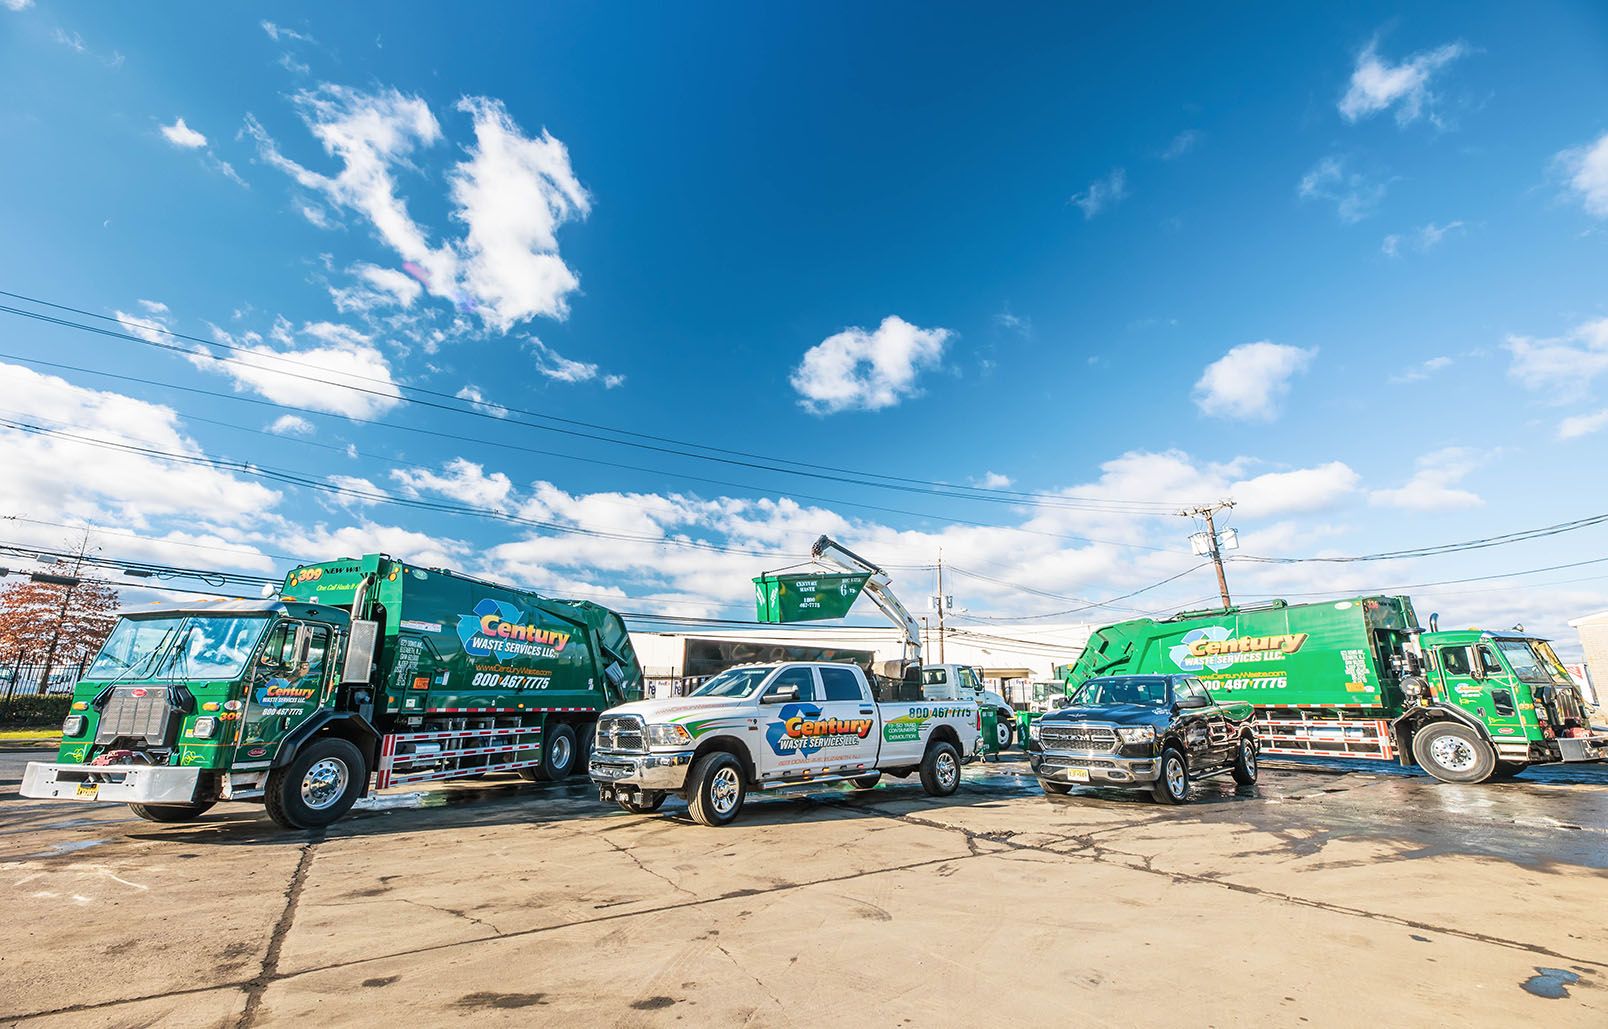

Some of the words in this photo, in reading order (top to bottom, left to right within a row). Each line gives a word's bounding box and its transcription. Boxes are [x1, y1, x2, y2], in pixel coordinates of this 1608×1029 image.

[298, 568, 323, 582] 309
[840, 584, 847, 596] 6
[480, 614, 571, 652] Century
[472, 637, 505, 651] WASTE
[504, 641, 541, 657] SERVICES
[1188, 633, 1309, 657] Century
[1184, 655, 1216, 667] WASTE
[1216, 653, 1261, 665] SERVICES
[1263, 651, 1286, 662] LLC.
[1198, 671, 1287, 681] ww.CenturyWaste.com
[267, 686, 315, 699] Century
[219, 712, 242, 721] 309
[785, 716, 873, 739] Century
[780, 738, 808, 750] WASTE
[809, 736, 844, 748] SERVICES
